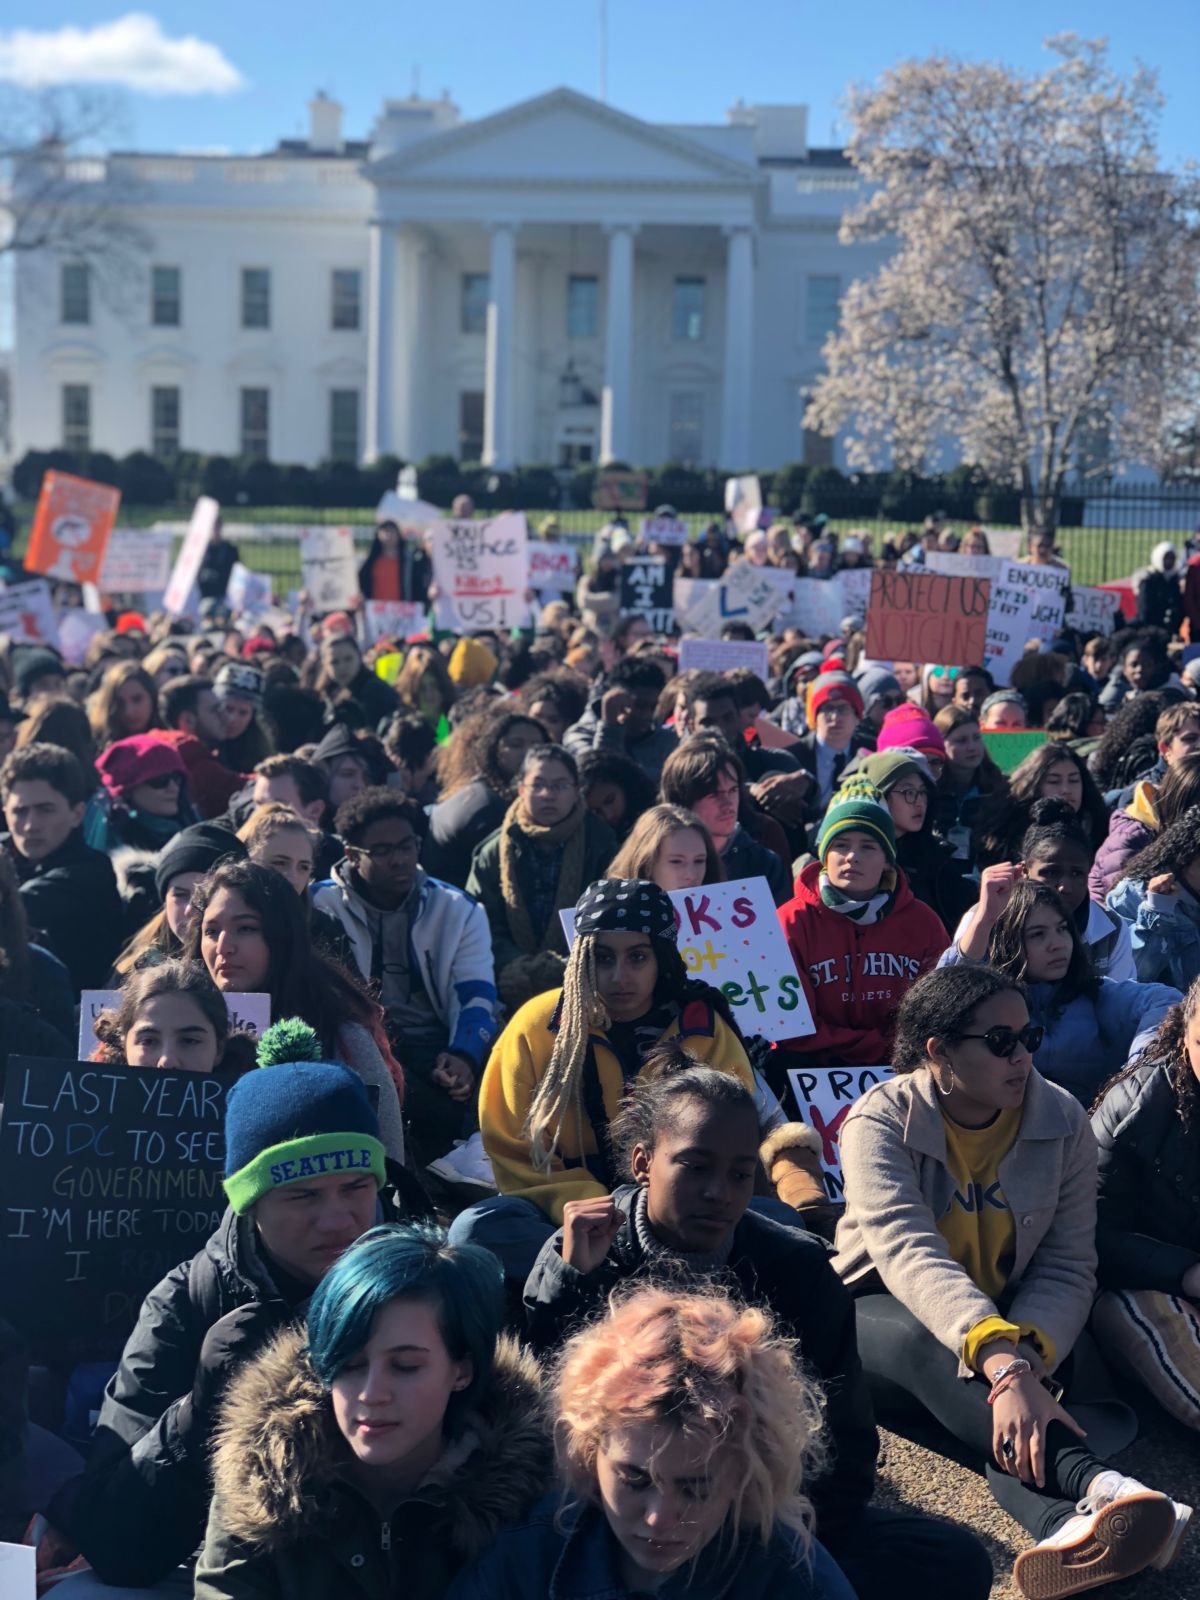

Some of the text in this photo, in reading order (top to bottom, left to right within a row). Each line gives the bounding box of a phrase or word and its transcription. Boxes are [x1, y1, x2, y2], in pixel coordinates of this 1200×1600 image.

[627, 566, 665, 587] AM
[871, 571, 952, 613] PROTECT
[961, 577, 990, 616] US
[1008, 568, 1066, 592] ENOUGH
[458, 600, 507, 625] US!
[634, 586, 655, 607] I
[681, 939, 727, 973] ot
[809, 958, 839, 989] ST.
[720, 970, 801, 1013] ets
[21, 1068, 223, 1120] LAST YEAR
[8, 1121, 225, 1164] TO DC TO SEE
[269, 1148, 372, 1184] SEATTLE
[7, 1207, 221, 1243] I'M HERE TODA
[64, 1250, 91, 1282] I
